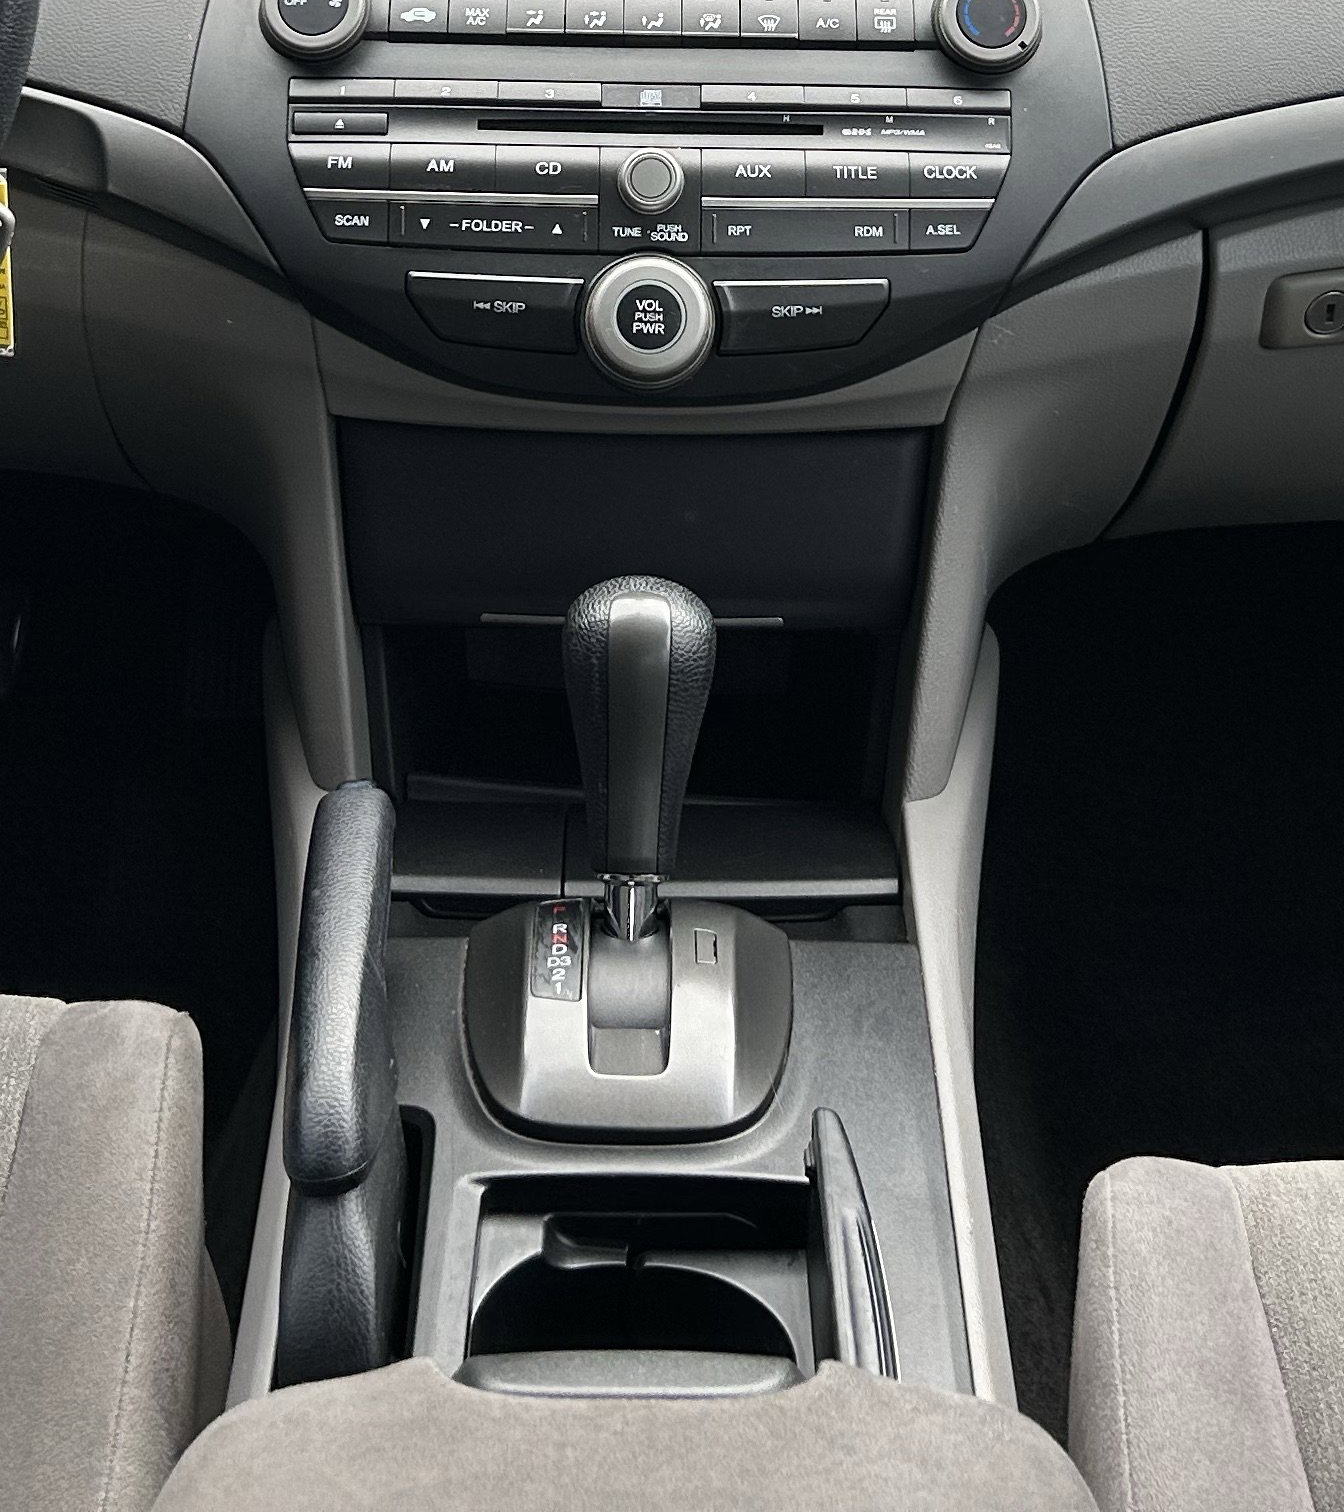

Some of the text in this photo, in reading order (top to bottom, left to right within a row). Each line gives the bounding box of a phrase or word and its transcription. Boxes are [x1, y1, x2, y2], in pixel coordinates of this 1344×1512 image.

[464, 7, 490, 18] MAX
[873, 7, 897, 16] REAR
[465, 15, 487, 27] A/C
[815, 17, 840, 30] A/C
[339, 85, 346, 96] 1
[440, 86, 452, 97] 2
[544, 88, 555, 99] 3
[747, 90, 757, 101] 4
[850, 93, 861, 104] 5
[953, 95, 963, 105] 6
[326, 156, 353, 170] FM
[426, 158, 455, 173] AM
[535, 161, 562, 176] CD
[734, 164, 772, 178] AUX
[832, 165, 878, 180] TITLE
[923, 165, 978, 180] CLOCK
[334, 214, 370, 227] SCAN
[612, 226, 642, 238] TUNE
[656, 223, 682, 232] PUSH
[727, 224, 753, 237] RPT
[853, 225, 884, 238] RDM
[925, 223, 961, 236] A.SEL
[650, 231, 689, 242] SOUND
[493, 300, 526, 314] SKIP
[635, 299, 664, 312] VOL
[771, 305, 804, 319] SKIP
[634, 312, 664, 322] PUSH
[632, 322, 666, 336] PWR
[552, 923, 568, 934] R
[552, 934, 568, 944] N
[551, 943, 568, 955] D
[547, 955, 572, 968] D3
[551, 968, 566, 981] 2
[555, 982, 562, 995] 1
